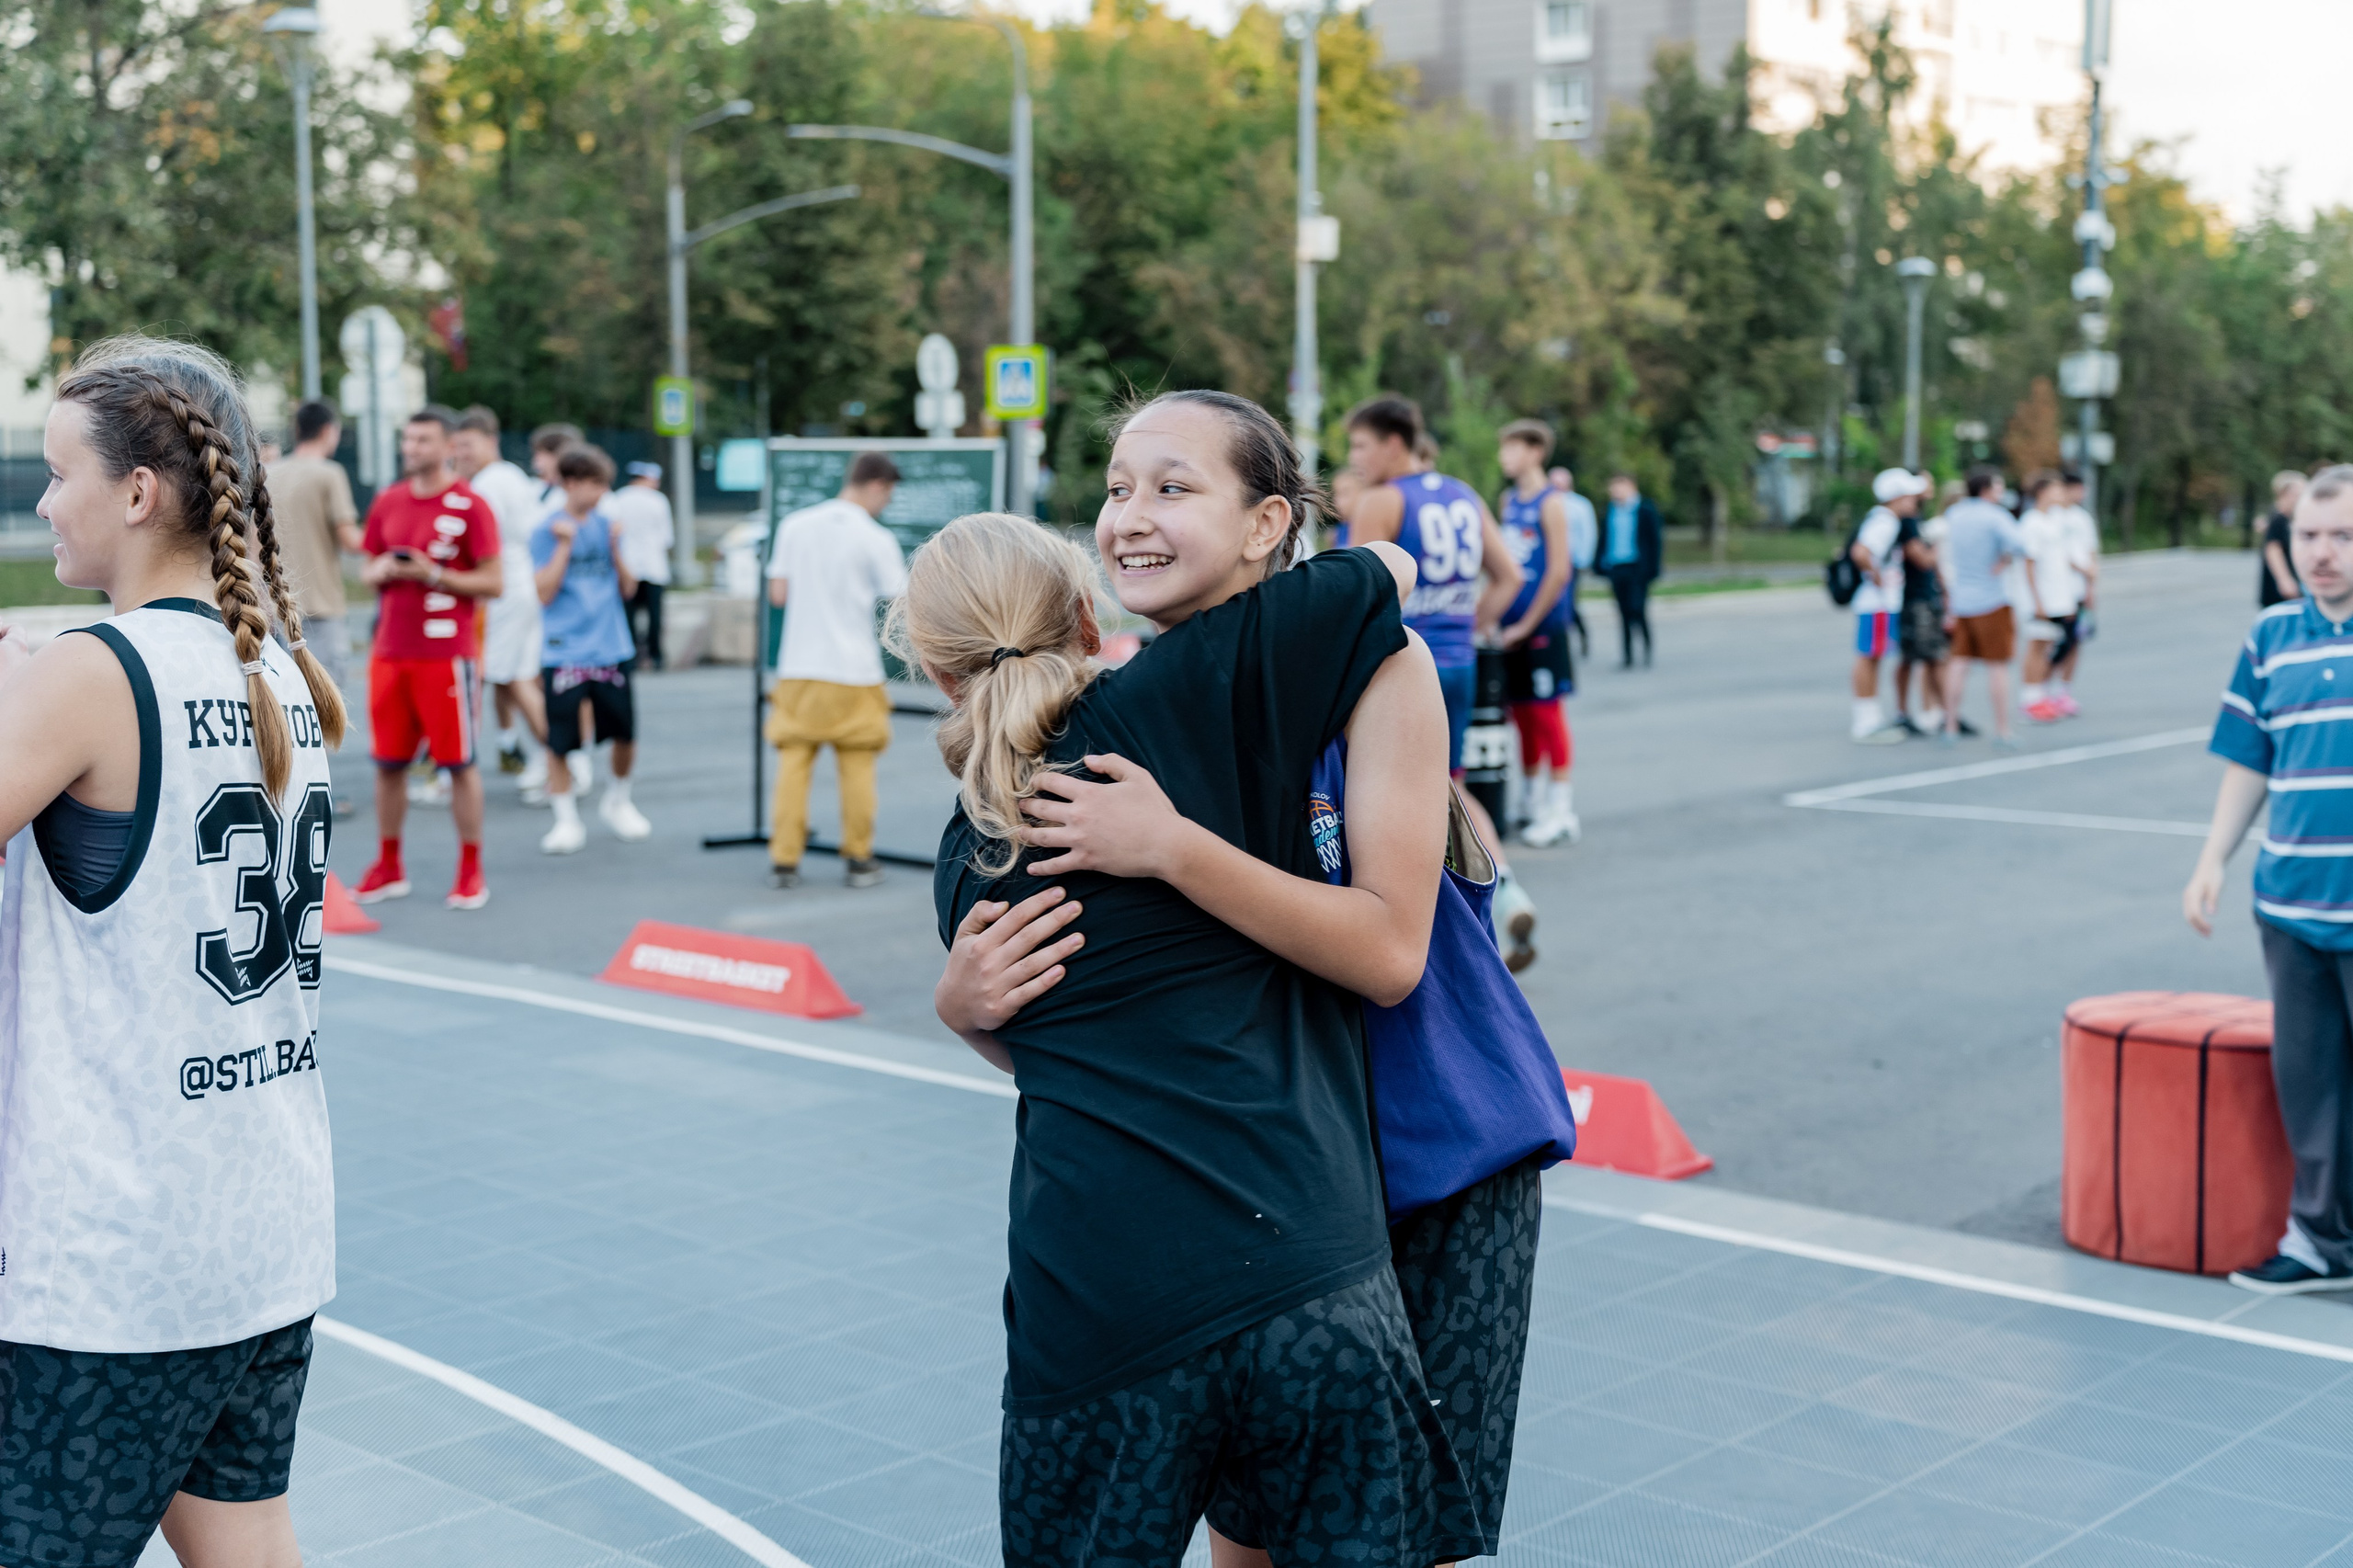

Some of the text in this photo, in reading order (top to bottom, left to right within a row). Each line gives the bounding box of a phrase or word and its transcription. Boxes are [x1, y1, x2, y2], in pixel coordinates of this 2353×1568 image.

[1418, 499, 1483, 583] 93
[184, 699, 324, 749] КУРОВ
[195, 783, 332, 1006] 38
